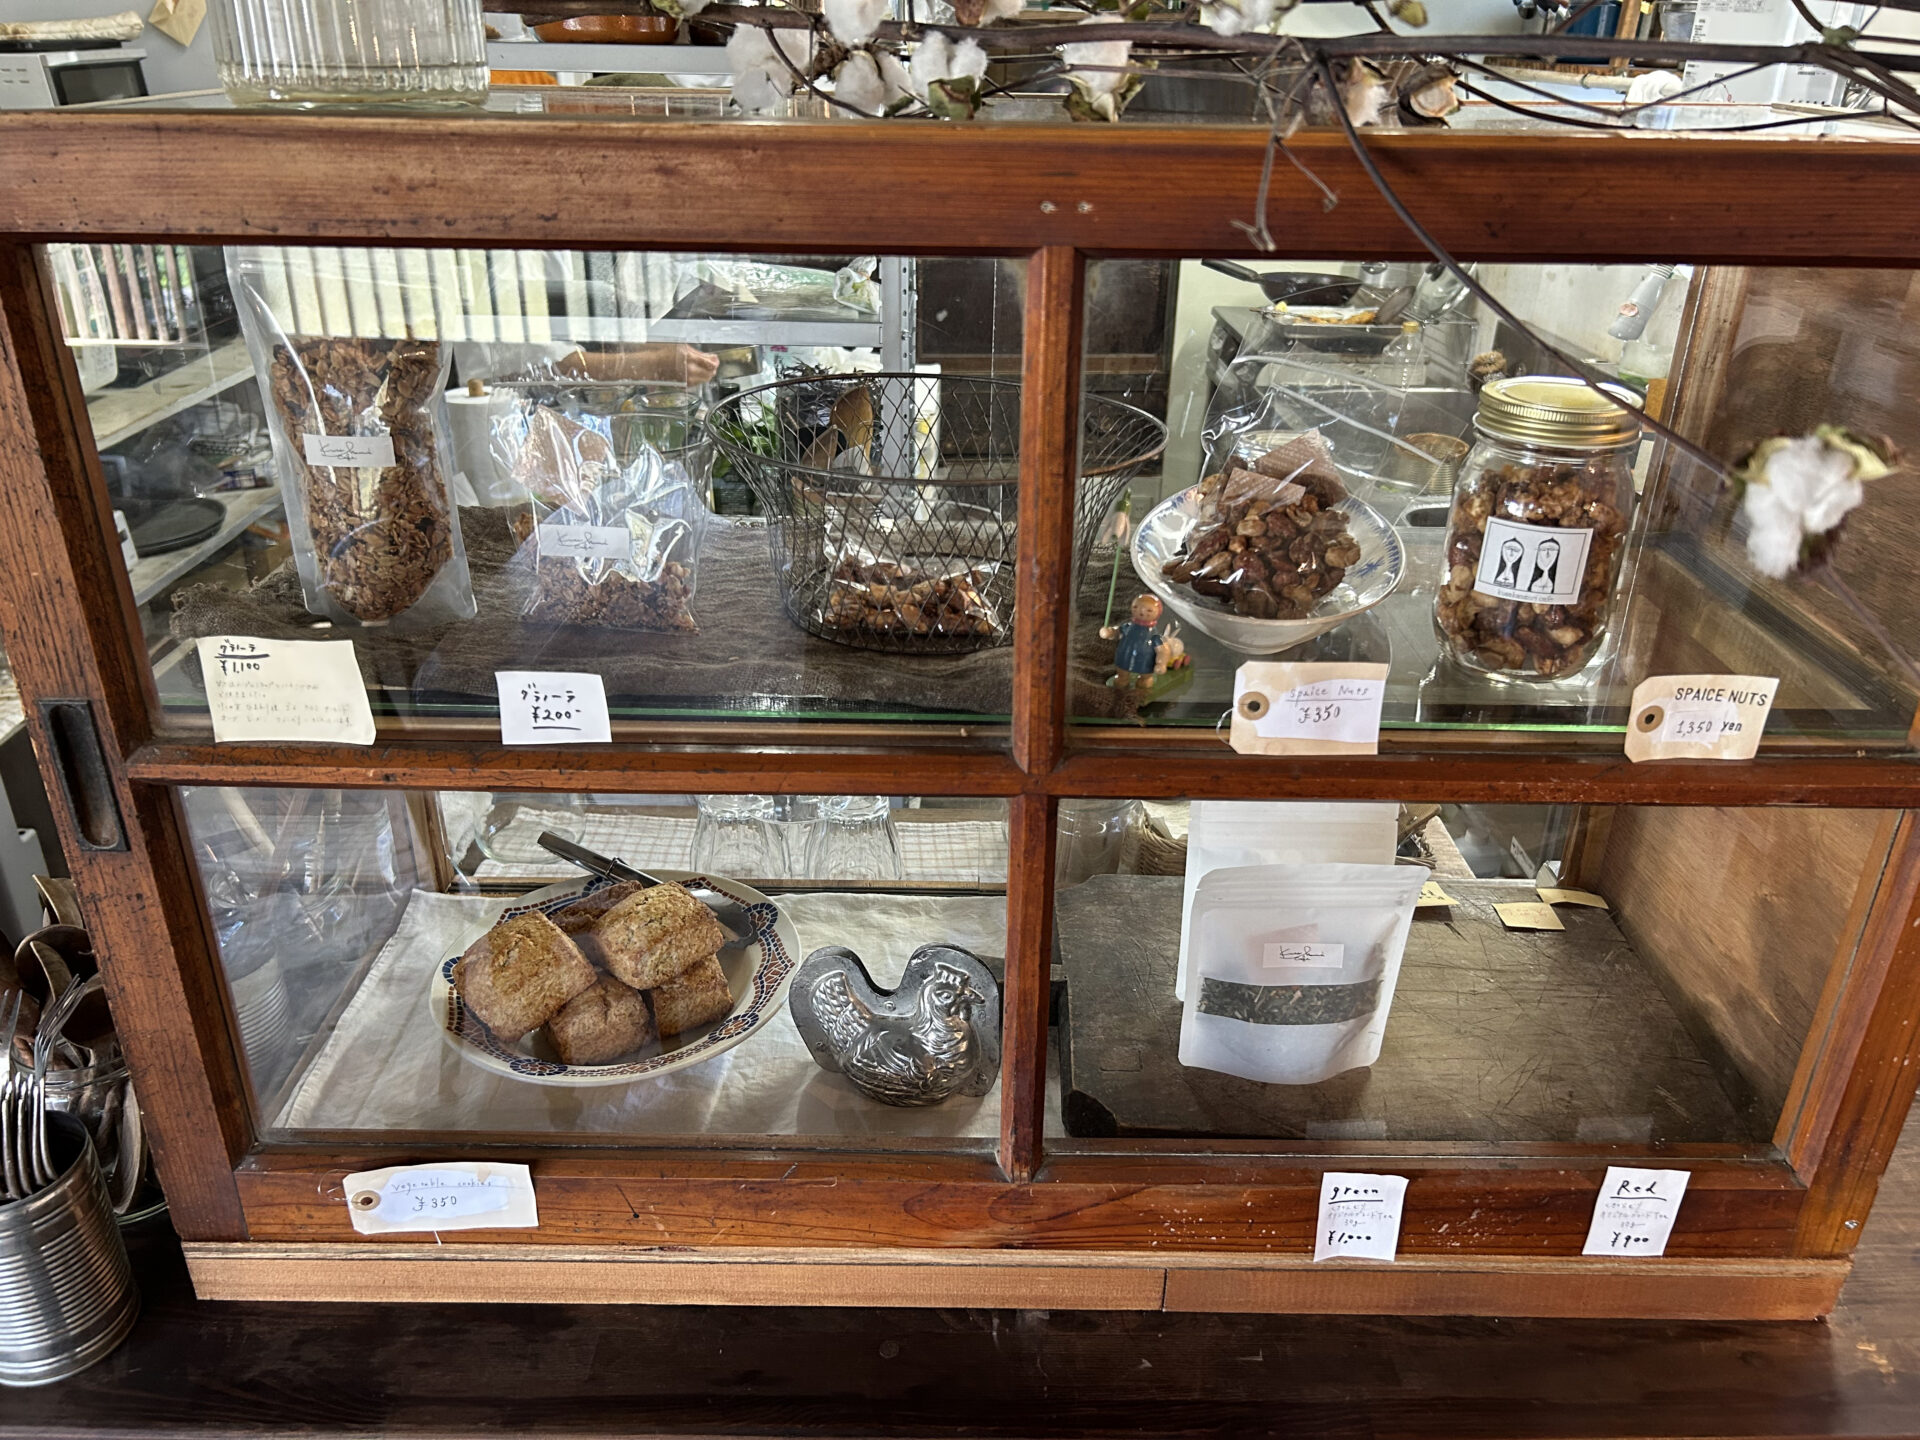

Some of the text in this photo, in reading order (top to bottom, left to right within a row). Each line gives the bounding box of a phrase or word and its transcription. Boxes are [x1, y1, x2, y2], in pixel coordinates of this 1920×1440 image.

[521, 683, 576, 703] グラノーラ
[1675, 687, 1768, 707] SPAICE NUTS
[1298, 704, 1341, 723] ¥350
[1720, 721, 1743, 732] yen
[1330, 1186, 1379, 1200] green
[1617, 1180, 1657, 1195] Red
[412, 1196, 457, 1212] ¥350
[1611, 1231, 1649, 1248] ¥900
